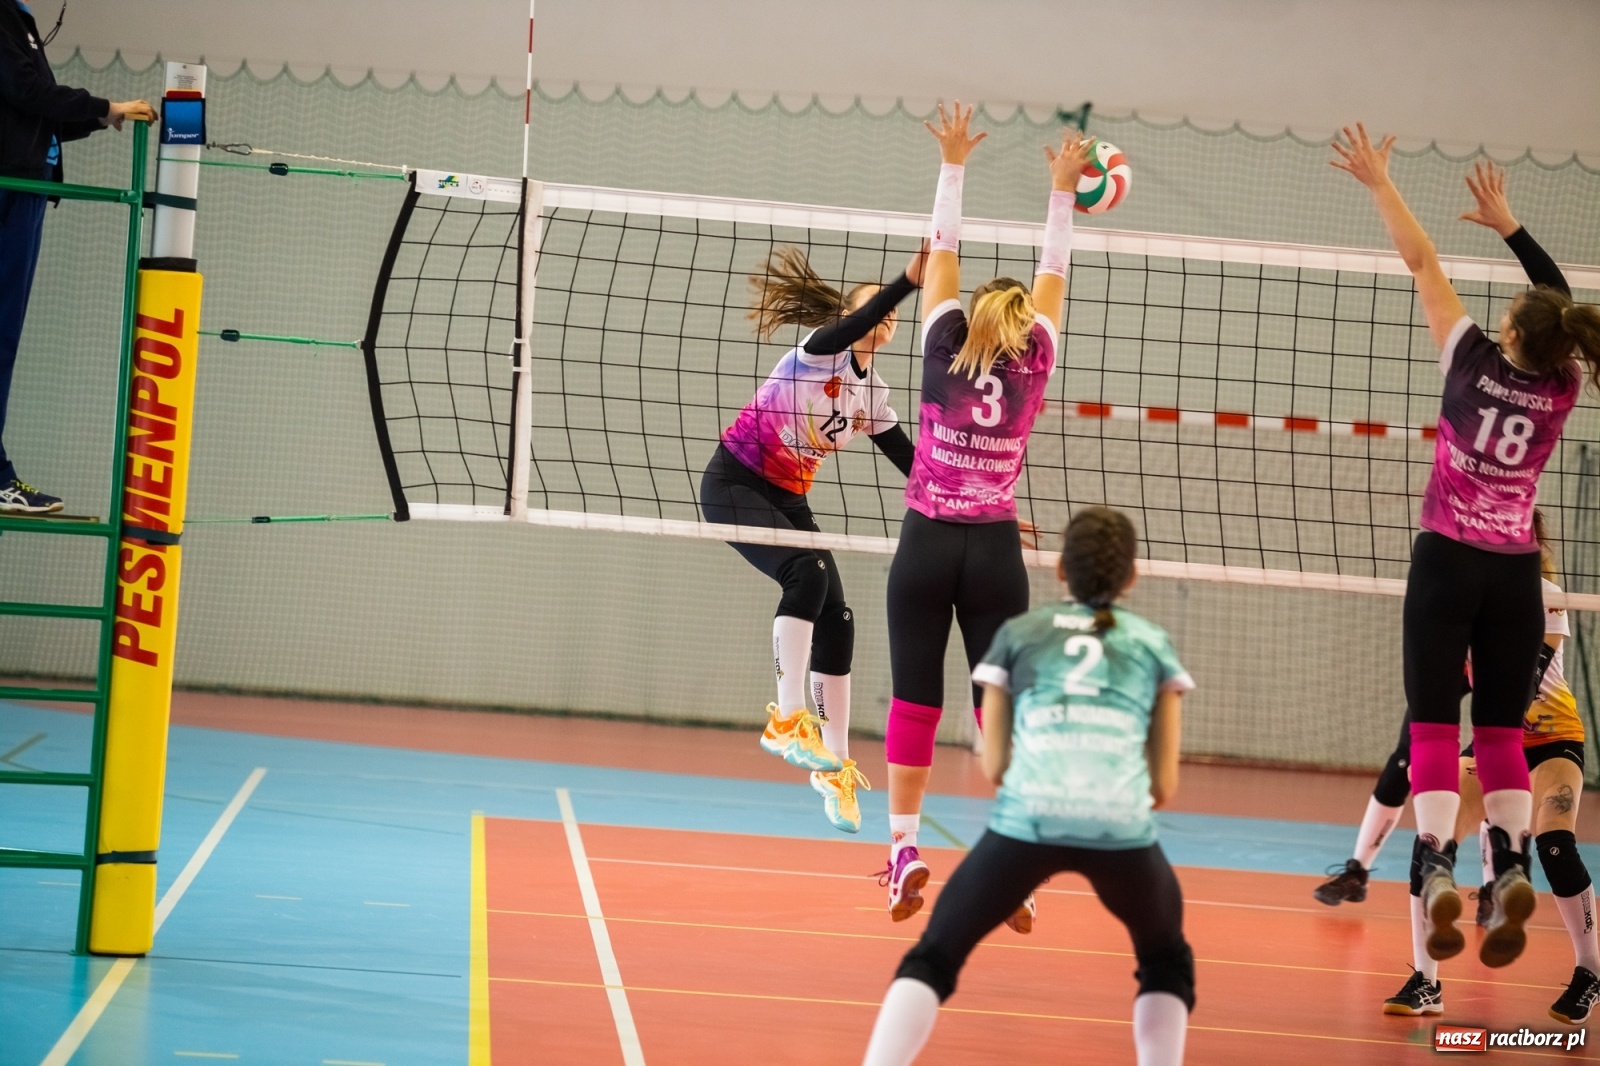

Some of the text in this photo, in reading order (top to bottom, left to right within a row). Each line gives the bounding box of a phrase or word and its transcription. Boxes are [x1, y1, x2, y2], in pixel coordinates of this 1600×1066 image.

[820, 409, 848, 443] 12
[971, 374, 1003, 427] 3
[933, 421, 1023, 452] MUKS NOMINUS
[1473, 406, 1535, 466] 18
[1063, 635, 1104, 696] 2
